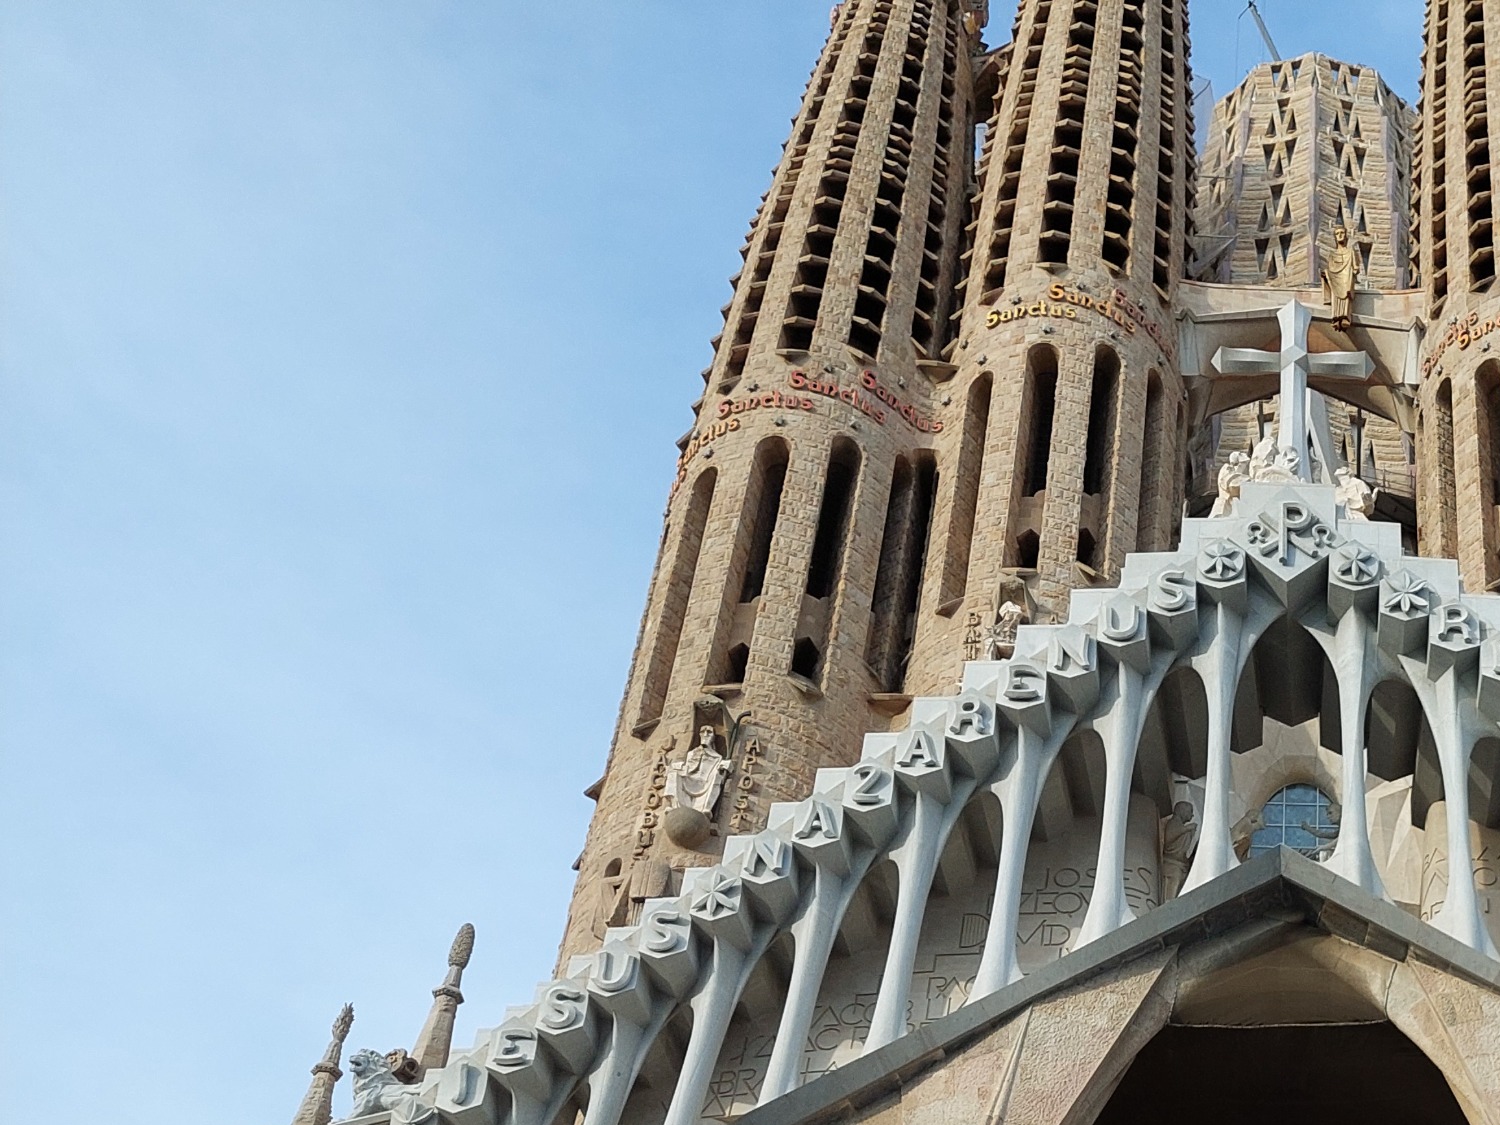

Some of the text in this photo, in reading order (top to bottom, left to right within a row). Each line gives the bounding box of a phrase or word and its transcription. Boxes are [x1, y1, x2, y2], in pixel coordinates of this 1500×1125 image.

[985, 300, 1078, 329] Sanctus
[1048, 282, 1137, 336] Sanctus
[717, 390, 814, 418] Sanctus
[790, 369, 886, 425] Sanctus
[861, 369, 944, 434] Sanctus
[452, 911, 680, 1104] JESUS
